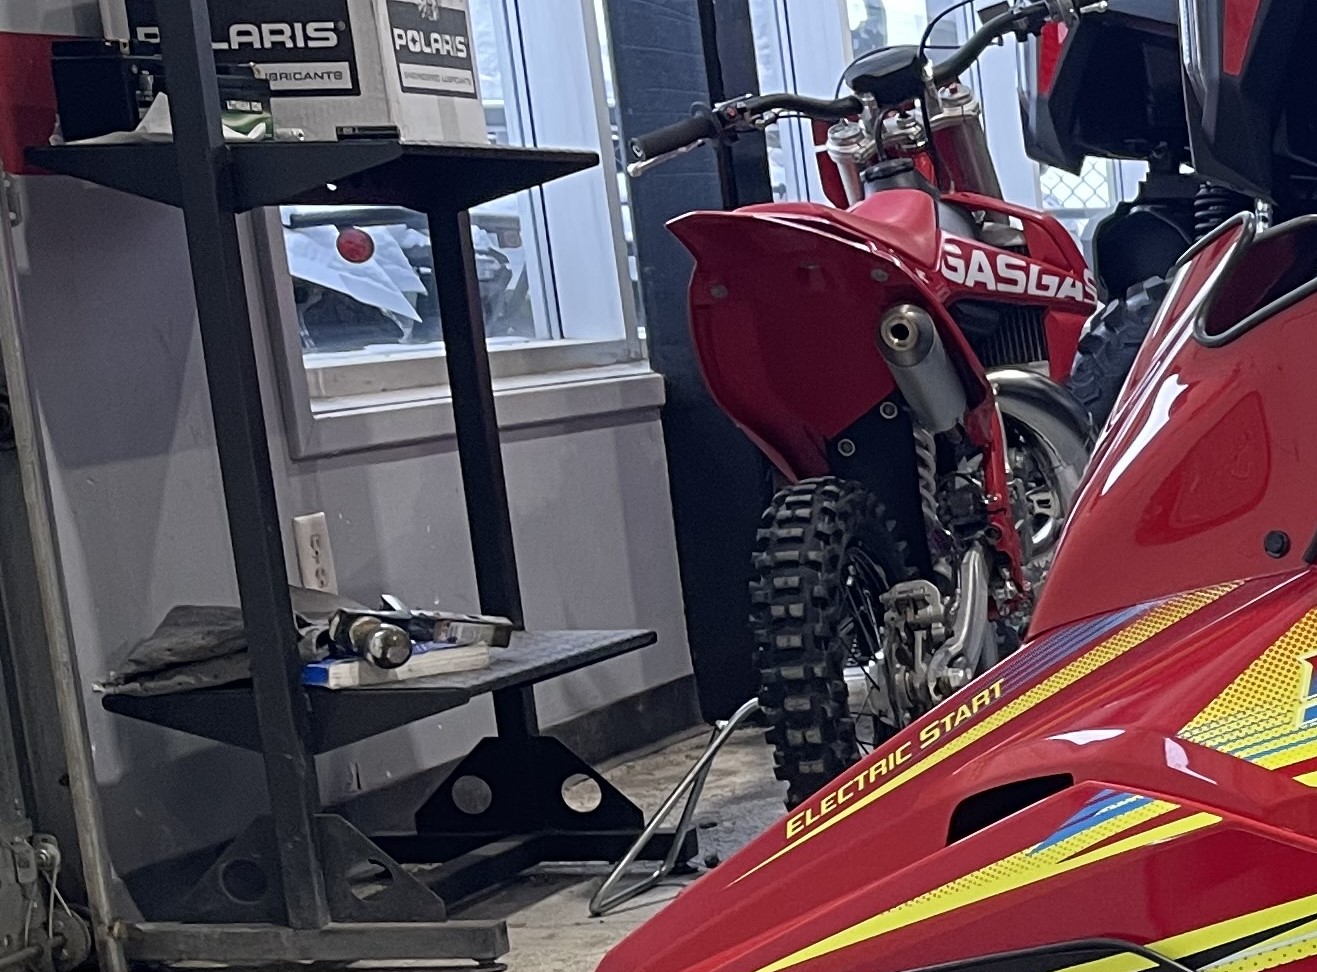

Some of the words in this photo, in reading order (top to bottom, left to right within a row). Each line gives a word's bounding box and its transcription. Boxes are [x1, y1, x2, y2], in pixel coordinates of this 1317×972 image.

[394, 27, 467, 59] POLARIS
[940, 242, 1098, 305] GASGAS
[785, 740, 913, 840] ELECTRIC
[918, 677, 1006, 750] START
